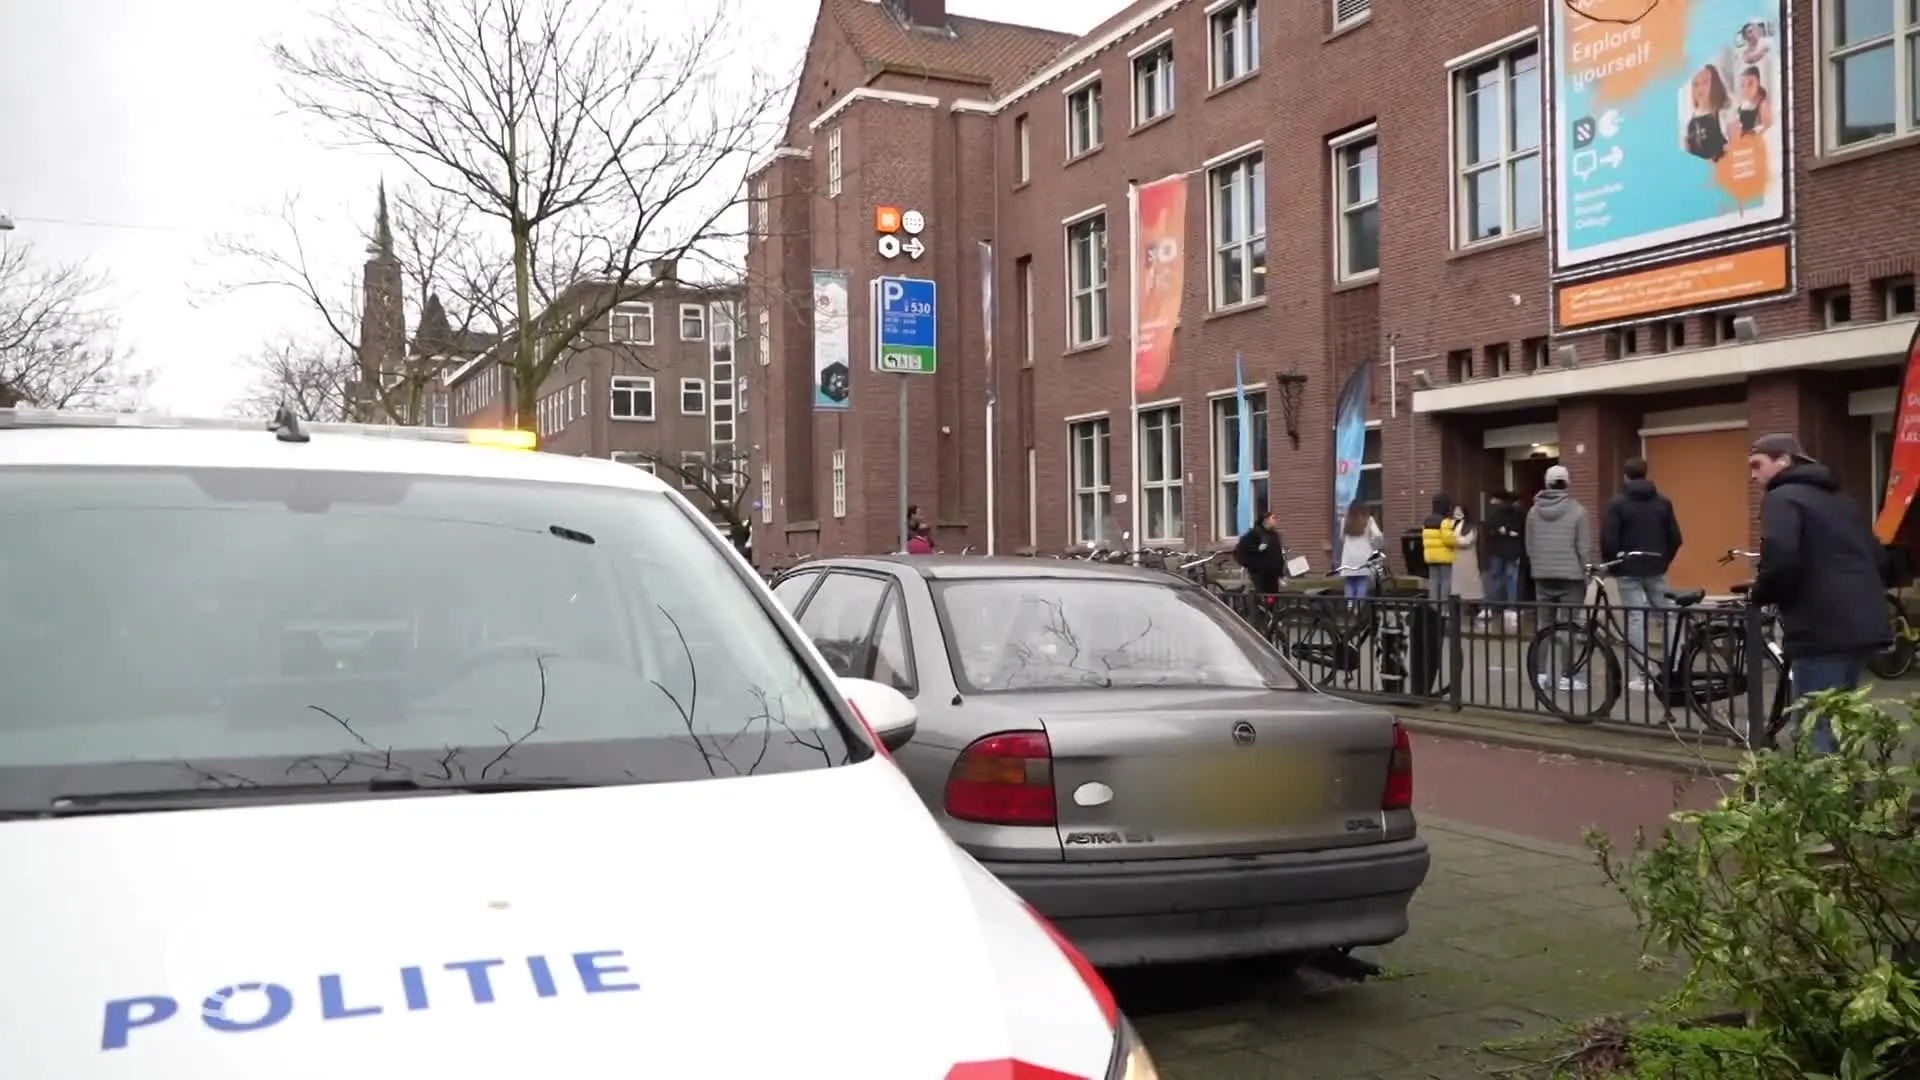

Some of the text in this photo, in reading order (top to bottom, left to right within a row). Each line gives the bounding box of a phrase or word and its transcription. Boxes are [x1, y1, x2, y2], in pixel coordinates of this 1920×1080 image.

[1572, 24, 1641, 63] Explore
[1573, 41, 1651, 92] yourself
[884, 281, 904, 311] P
[910, 302, 931, 313] 530
[1065, 831, 1122, 844] ASTRA
[100, 949, 642, 1052] POLITIE
